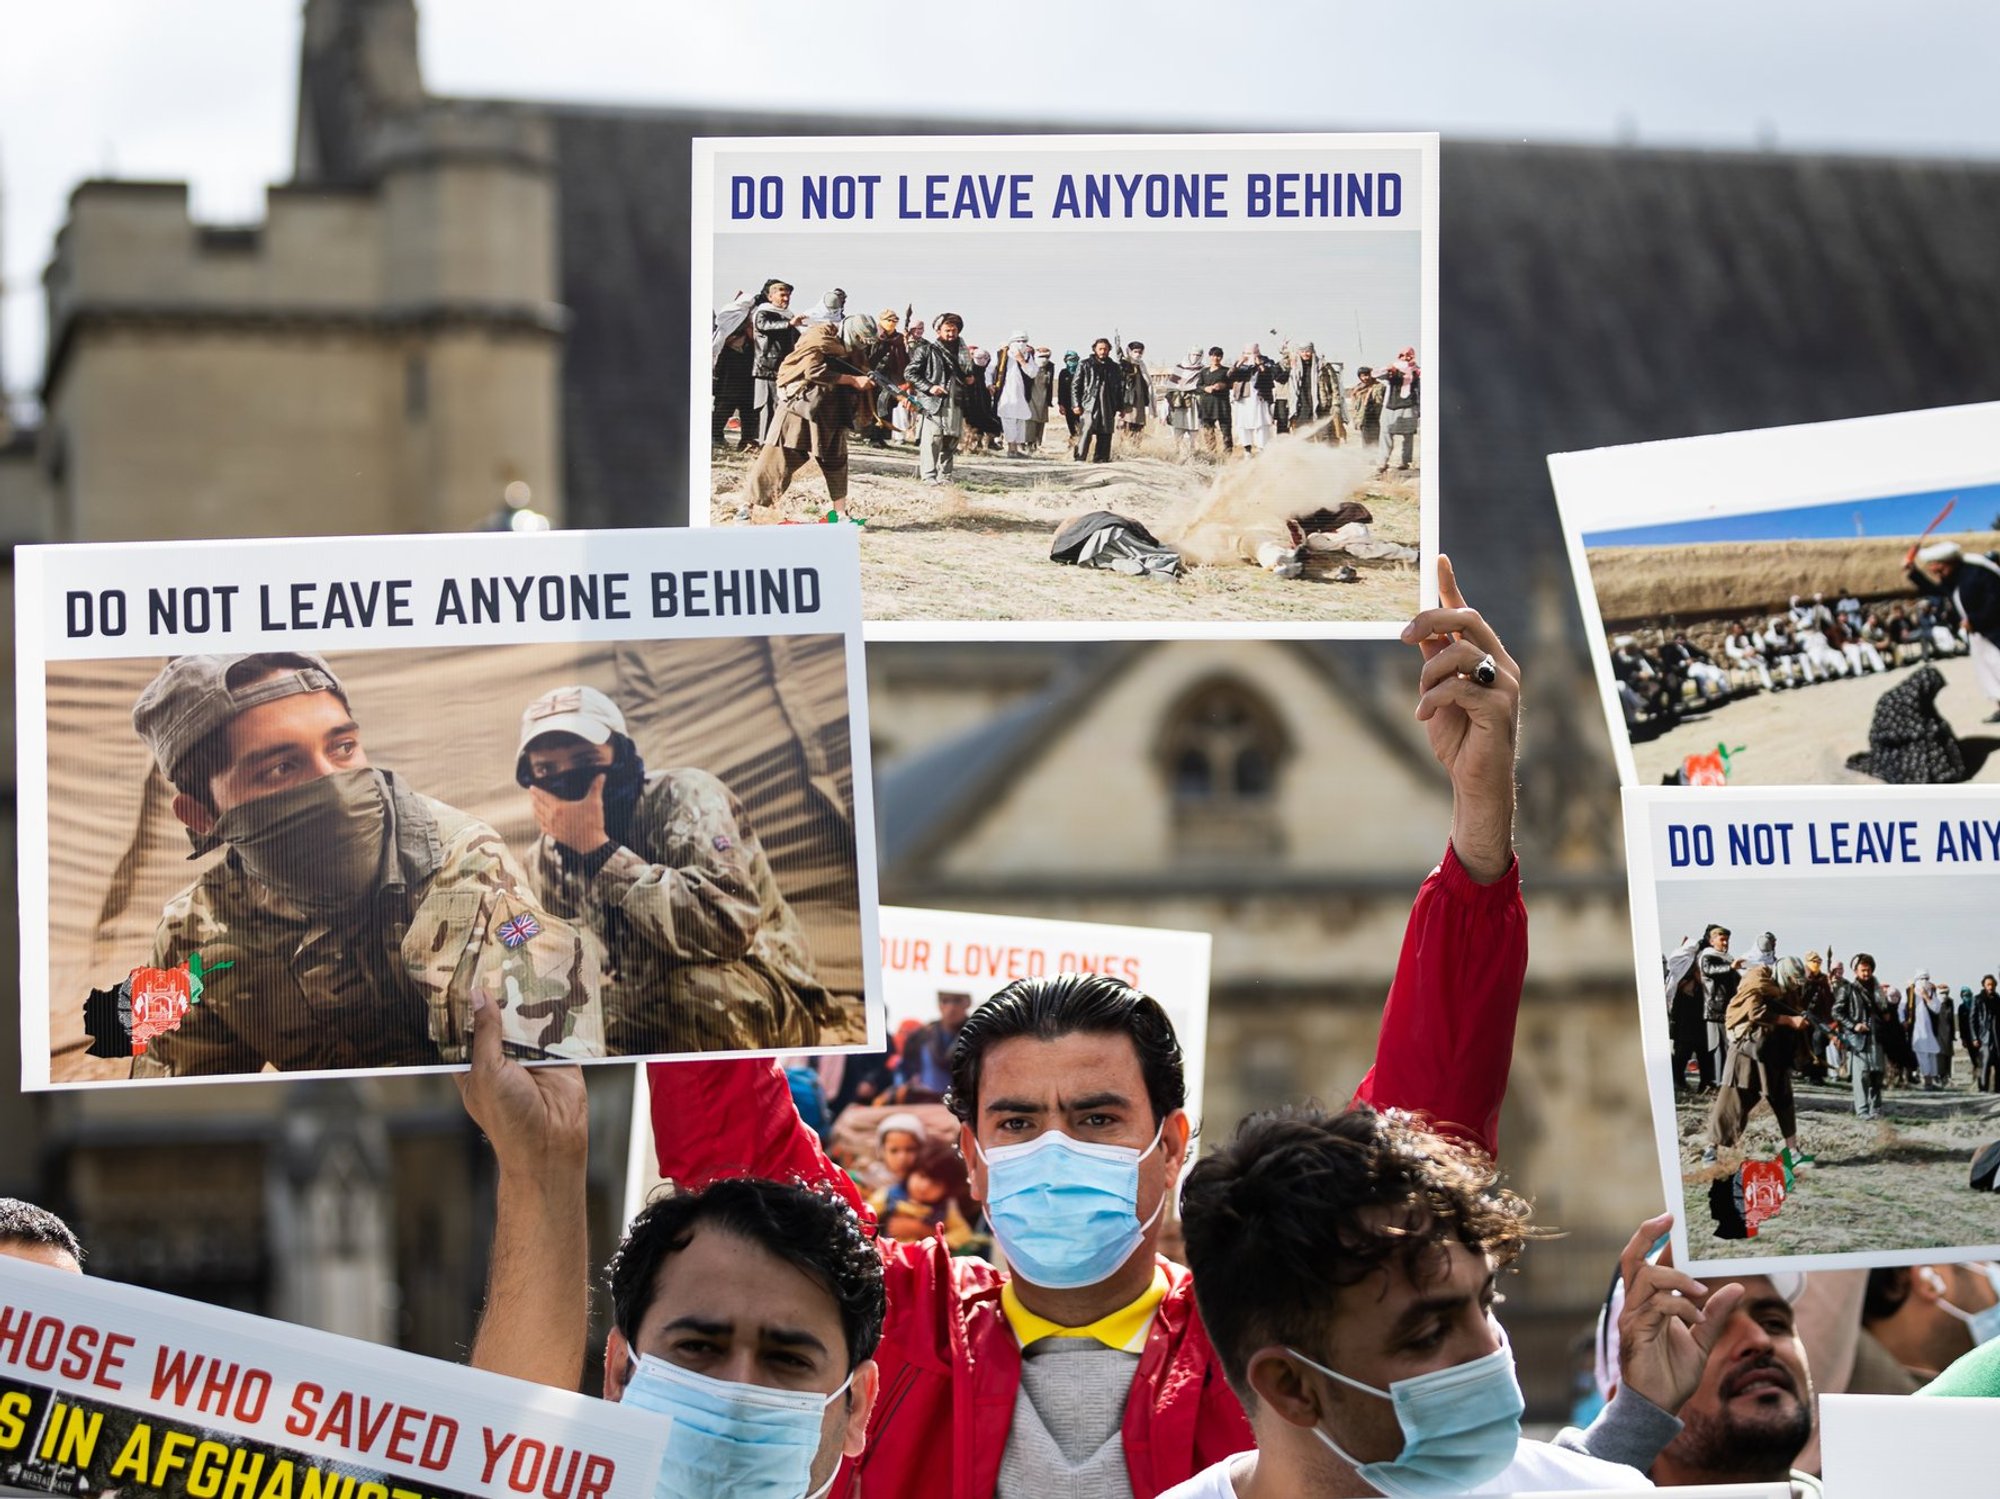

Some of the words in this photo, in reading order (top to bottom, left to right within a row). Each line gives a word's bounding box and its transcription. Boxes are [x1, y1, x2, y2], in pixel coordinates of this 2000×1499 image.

[732, 176, 783, 219] DO
[802, 176, 881, 219] NOT
[899, 175, 1033, 219] LEAVE
[1052, 174, 1228, 218] ANYONE
[1247, 172, 1402, 218] BEHIND
[66, 590, 126, 637] DO
[149, 586, 239, 634] NOT
[260, 580, 413, 631] LEAVE
[435, 573, 631, 625] ANYONE
[651, 567, 821, 618] BEHIND
[1668, 824, 1715, 867] DO
[1728, 823, 1794, 866] NOT
[1808, 821, 1921, 864] LEAVE
[1936, 820, 2000, 862] ANY
[944, 941, 1045, 979] LOVED
[1059, 951, 1140, 989] ONES
[0, 1305, 136, 1391] HOSE
[150, 1344, 273, 1424] WHO
[285, 1381, 460, 1472] SAVED
[480, 1426, 616, 1499] YOUR
[40, 1402, 104, 1469] IN
